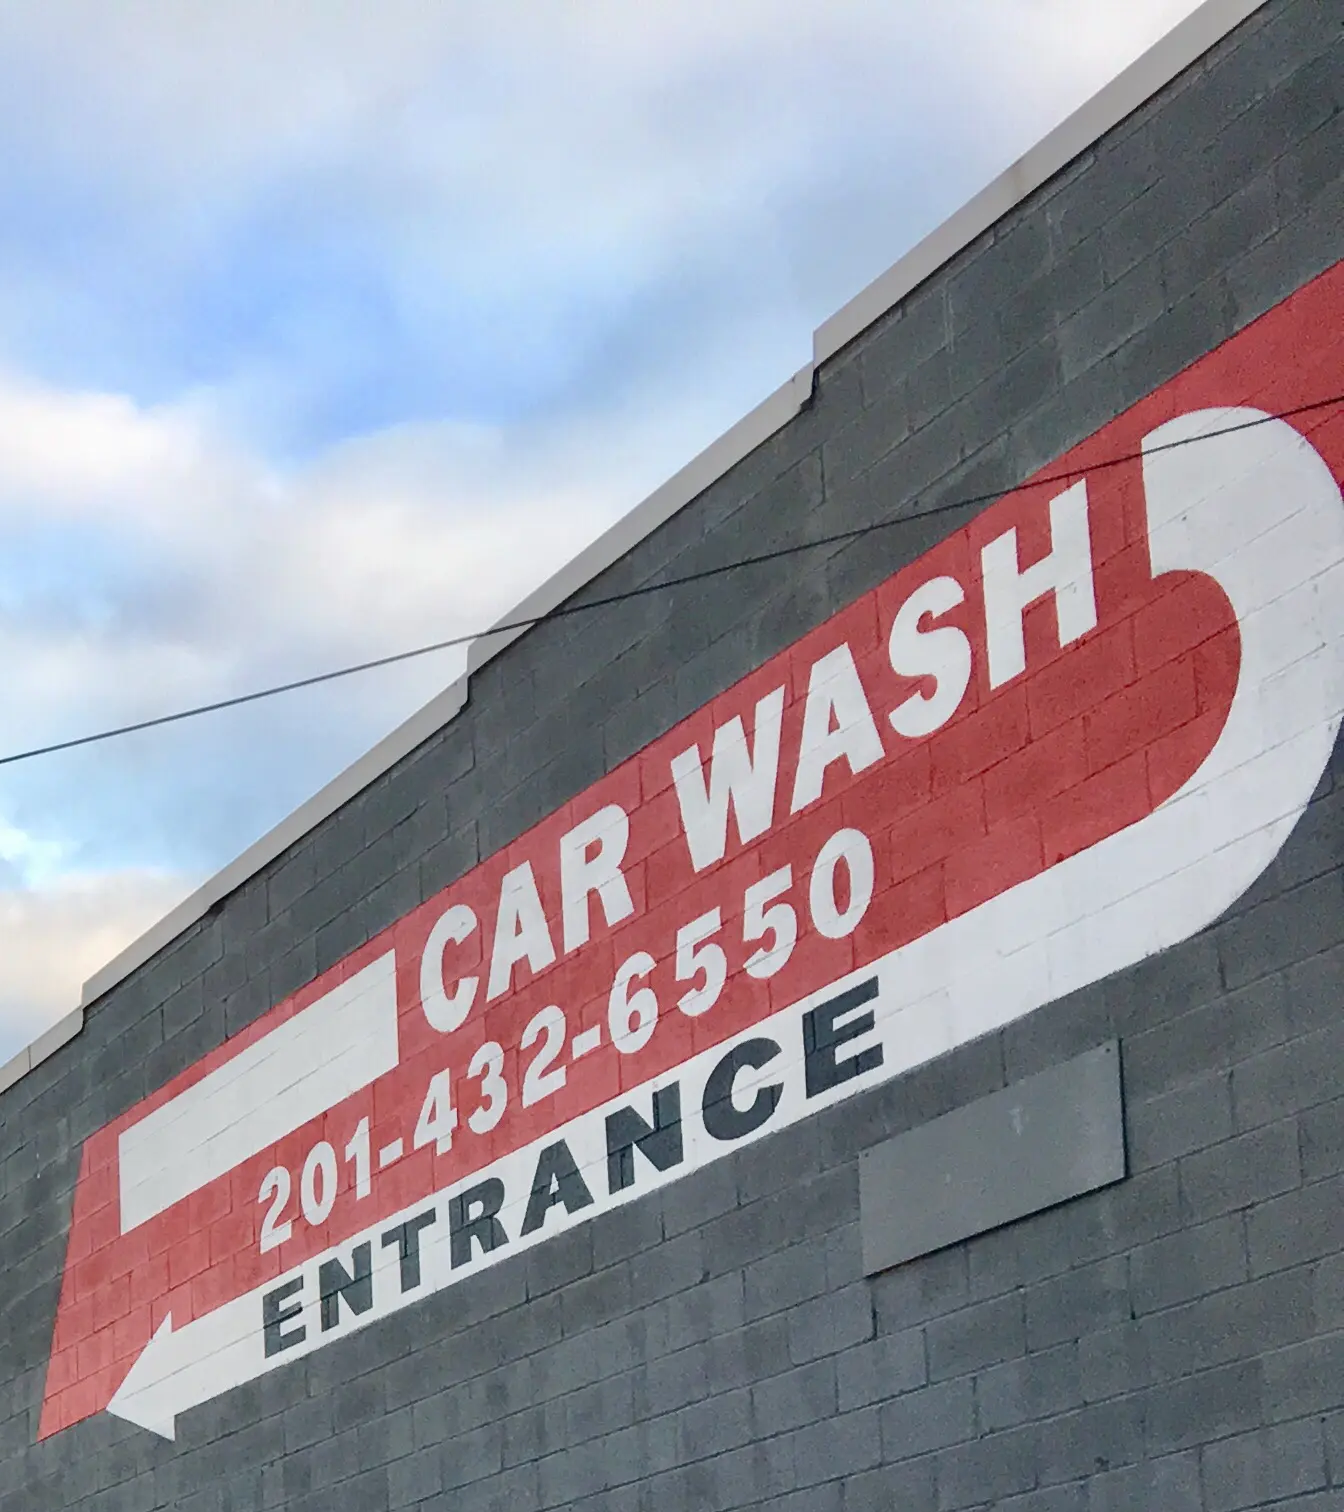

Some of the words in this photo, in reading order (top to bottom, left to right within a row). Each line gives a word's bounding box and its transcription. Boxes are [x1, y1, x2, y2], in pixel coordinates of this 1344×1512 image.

[421, 804, 633, 1033] CAR
[671, 480, 1099, 873] WASH
[259, 827, 875, 1253] 201-432-6550
[263, 975, 886, 1358] ENTRANCE
